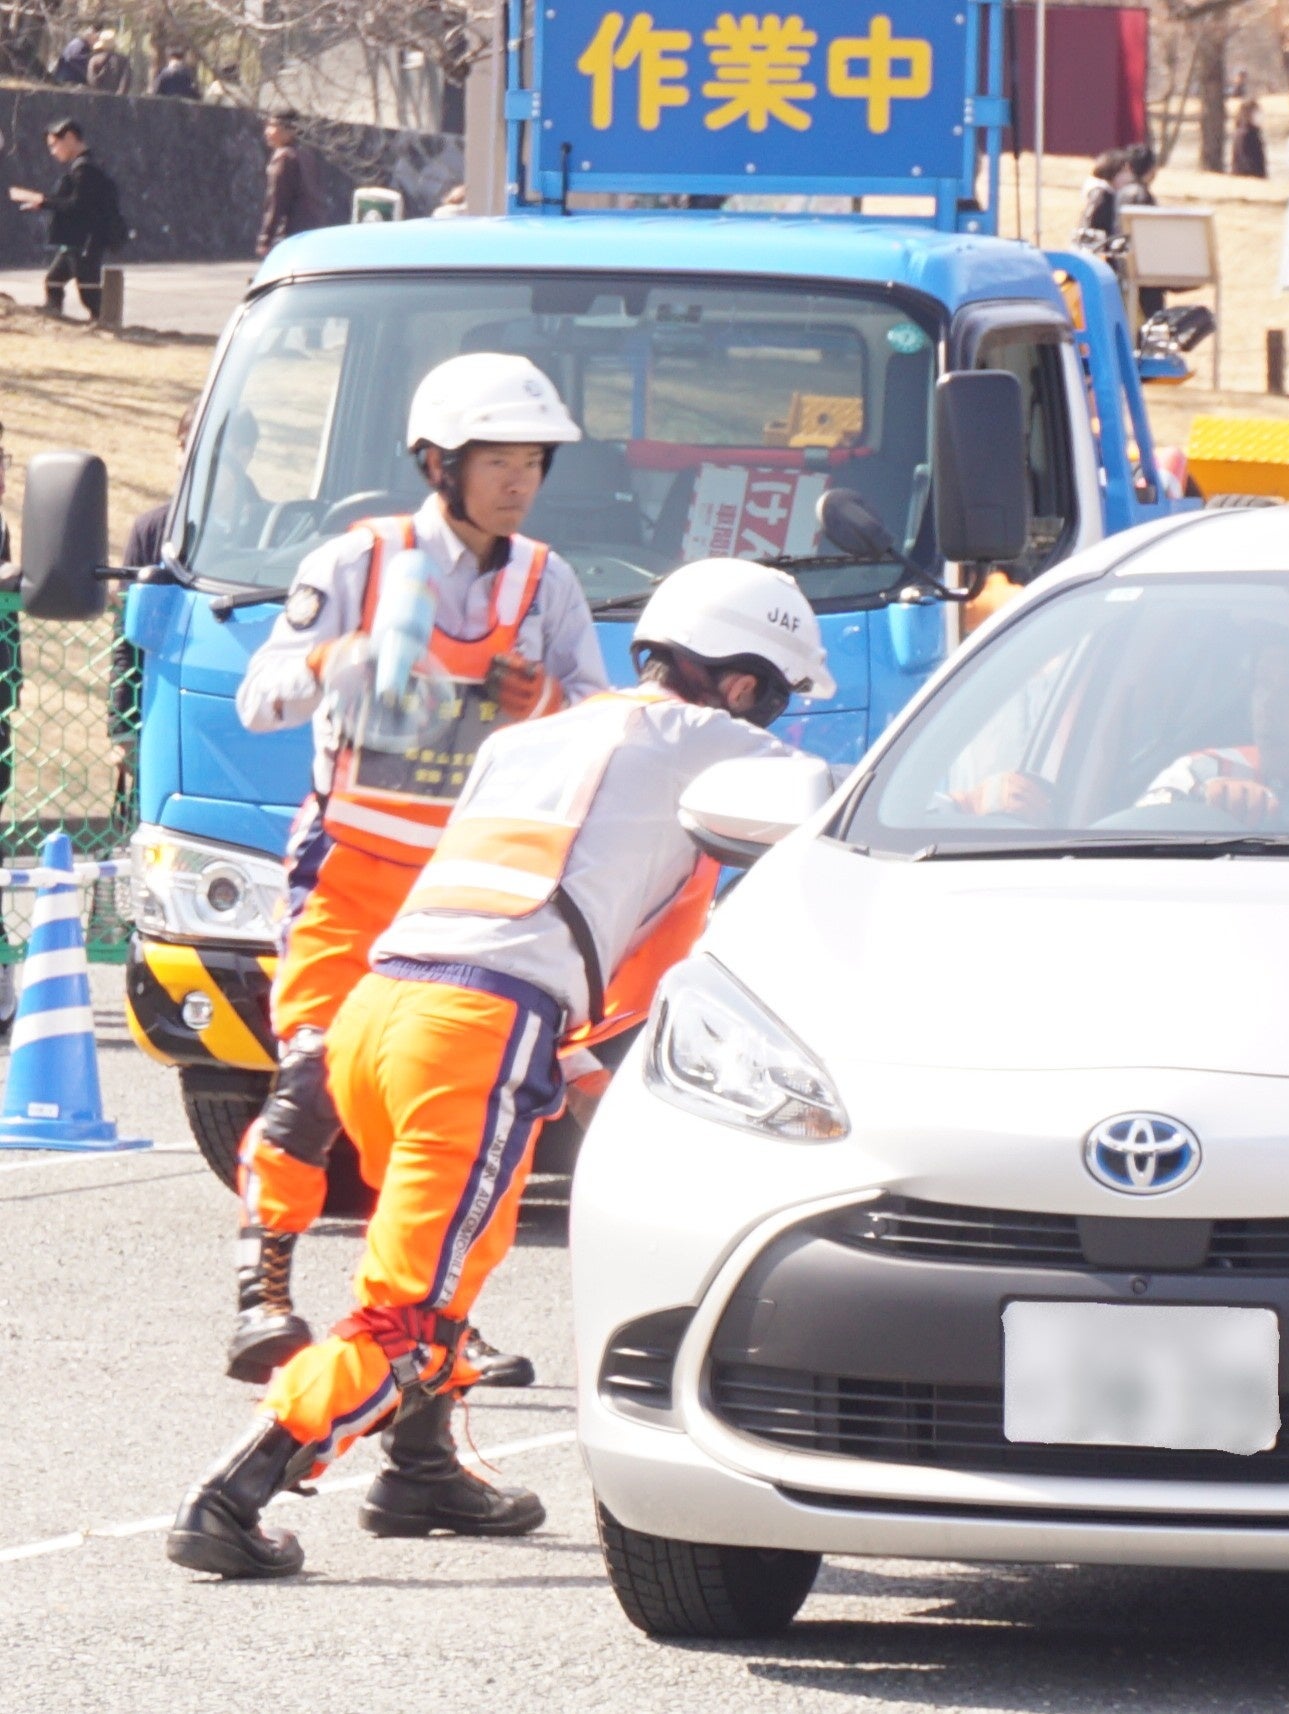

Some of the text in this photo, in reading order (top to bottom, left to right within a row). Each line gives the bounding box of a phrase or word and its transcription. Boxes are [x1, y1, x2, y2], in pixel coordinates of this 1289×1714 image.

[577, 12, 932, 133] 作業中
[767, 607, 800, 632] JAF
